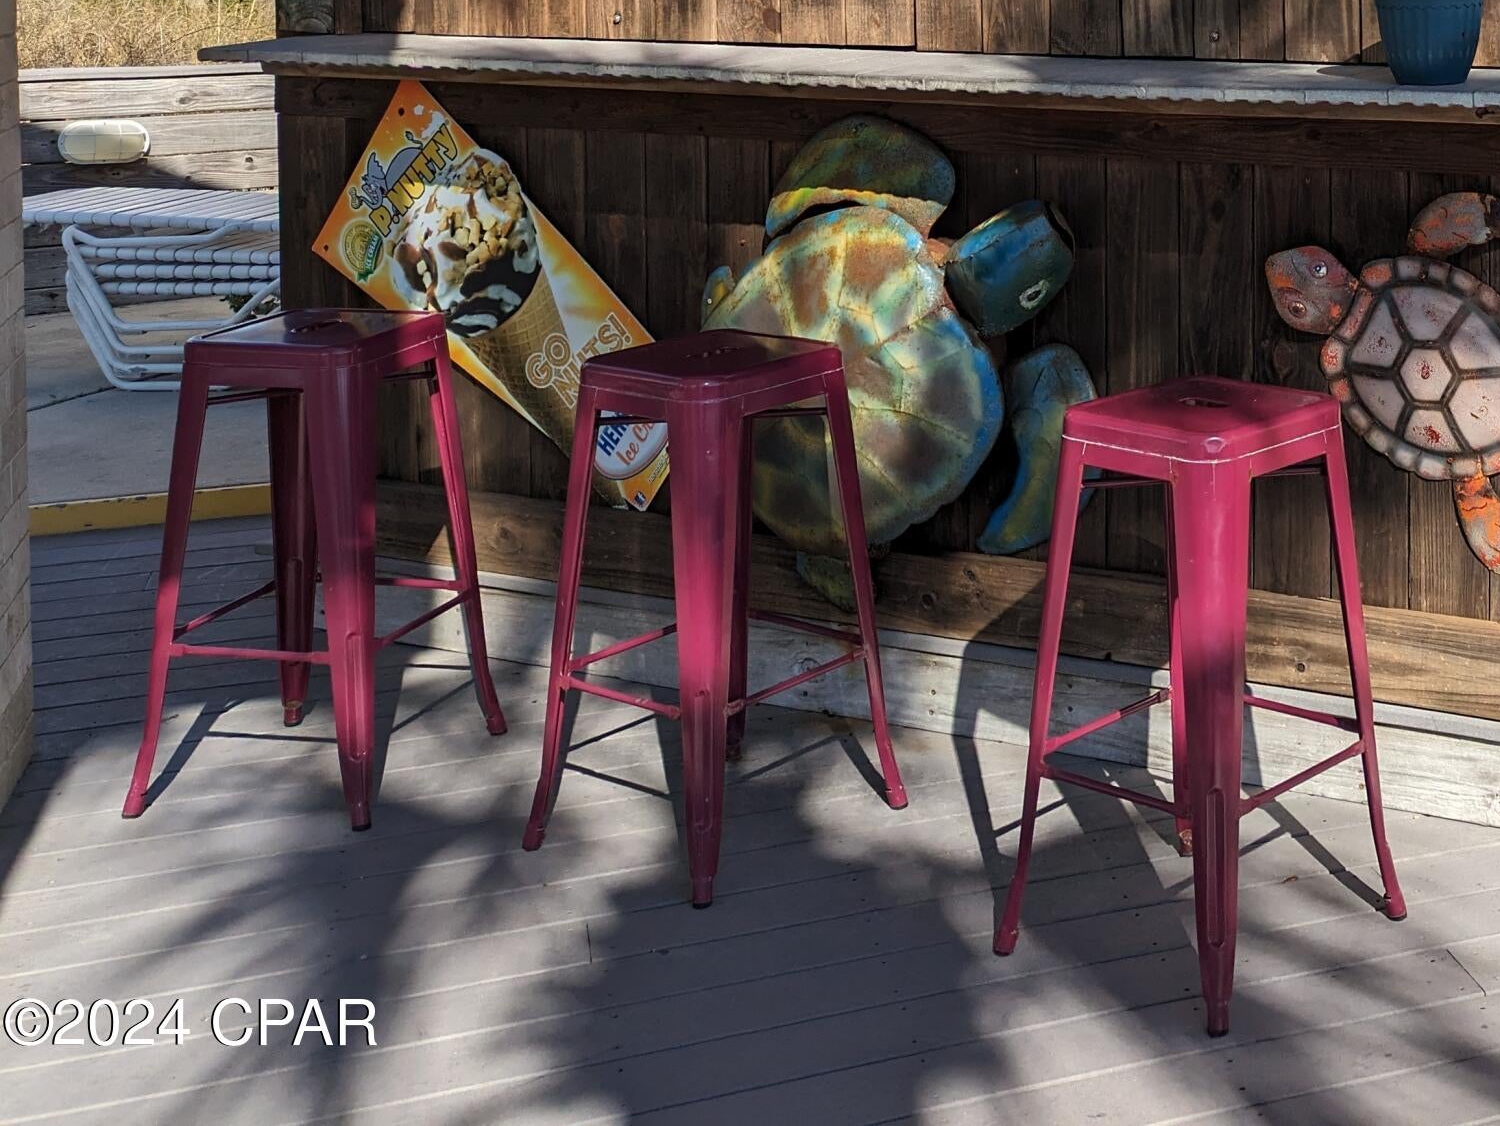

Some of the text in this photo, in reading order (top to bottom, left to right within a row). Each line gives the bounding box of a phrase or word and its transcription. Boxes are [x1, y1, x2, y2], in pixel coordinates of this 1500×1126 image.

[369, 122, 458, 238] P.NUTTY
[525, 332, 572, 389] GO
[615, 442, 640, 466] Ice
